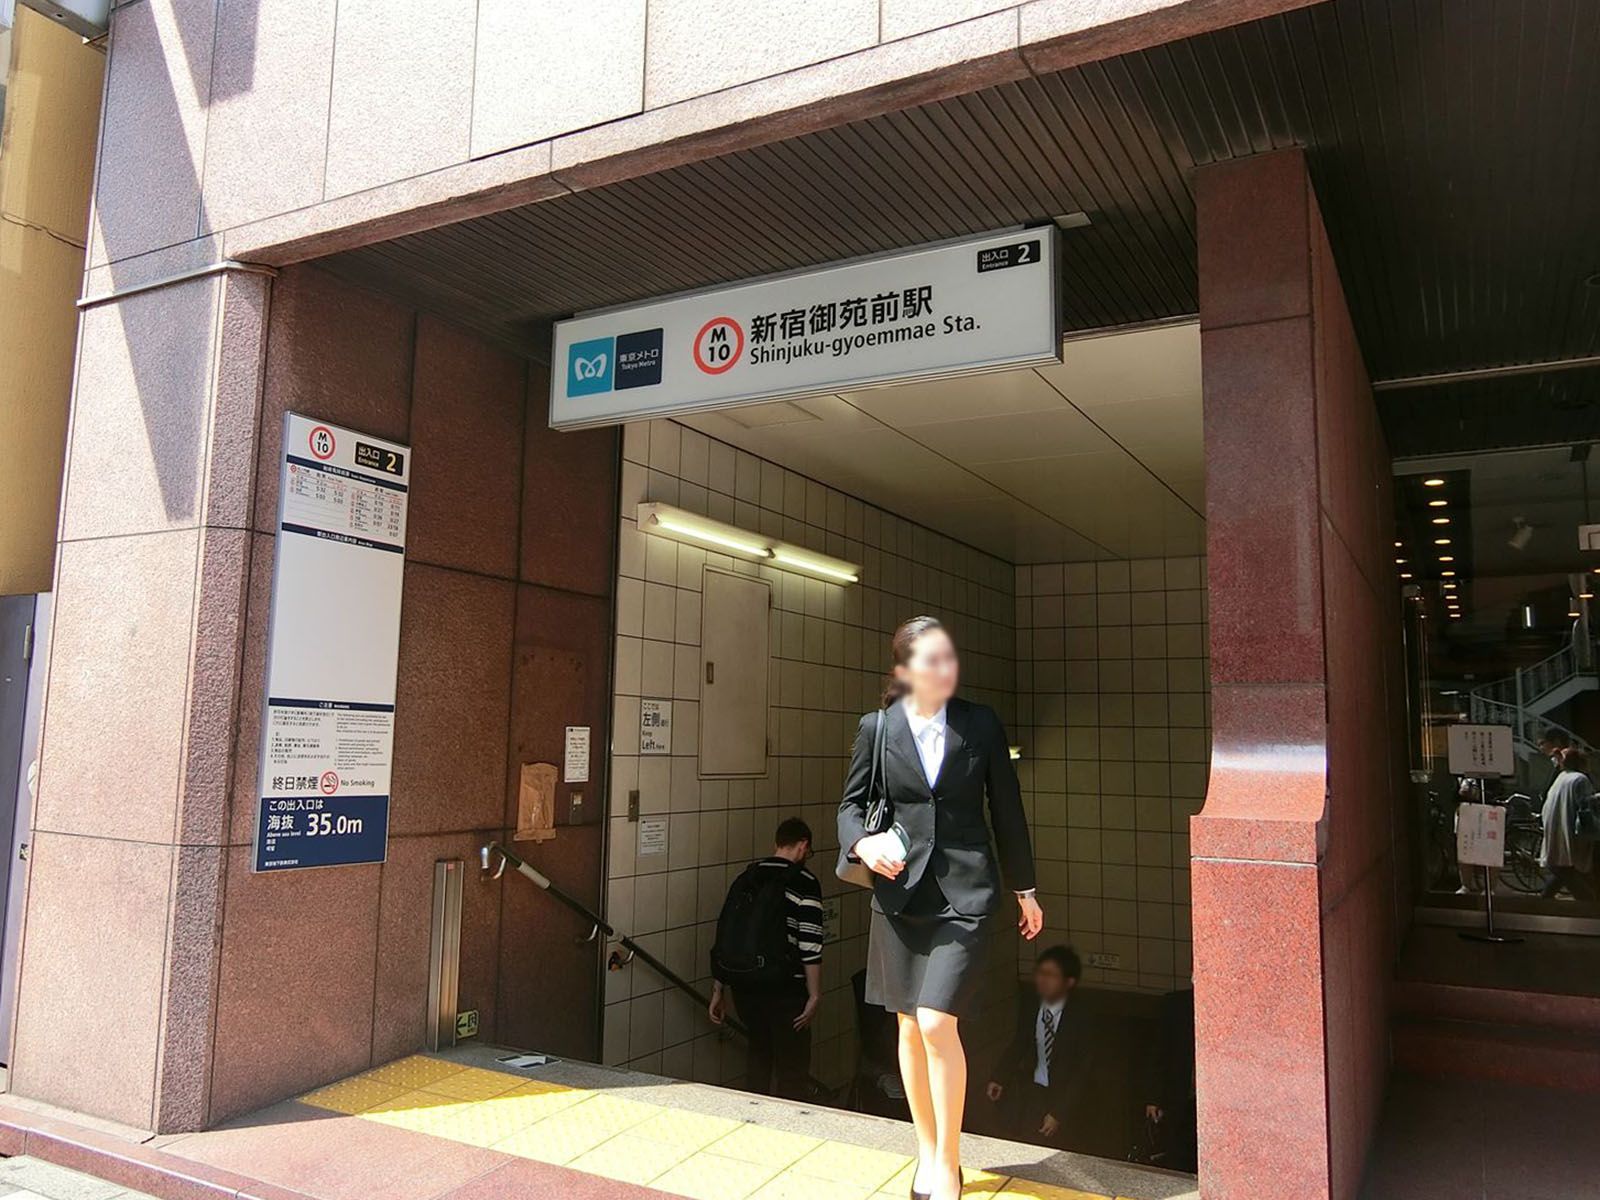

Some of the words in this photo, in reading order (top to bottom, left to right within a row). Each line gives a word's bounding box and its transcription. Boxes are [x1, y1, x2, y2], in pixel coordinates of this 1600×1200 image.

[981, 249, 1009, 263] 出入口
[1017, 244, 1031, 263] 2
[981, 260, 1009, 270] Entrance
[750, 285, 933, 345] 新宿御苑前駅
[710, 326, 727, 344] M
[750, 322, 936, 365] Shinjuku-gyoemmae
[943, 314, 981, 335] Sta.
[620, 348, 659, 362] 東京メトロ
[708, 343, 731, 362] 10
[621, 362, 638, 370] Tokyo
[638, 359, 656, 368] Metro
[318, 432, 328, 442] M
[316, 442, 329, 453] 10
[358, 446, 380, 460] 出入口
[386, 453, 397, 473] 2
[358, 456, 379, 467] Entrance
[641, 739, 655, 750] Left
[272, 776, 318, 790] 終日禁煙
[340, 779, 349, 787] No
[350, 779, 375, 788] Smoking
[269, 799, 324, 811] この出入口は
[267, 814, 295, 831] 海抜
[306, 812, 363, 837] 35.0m
